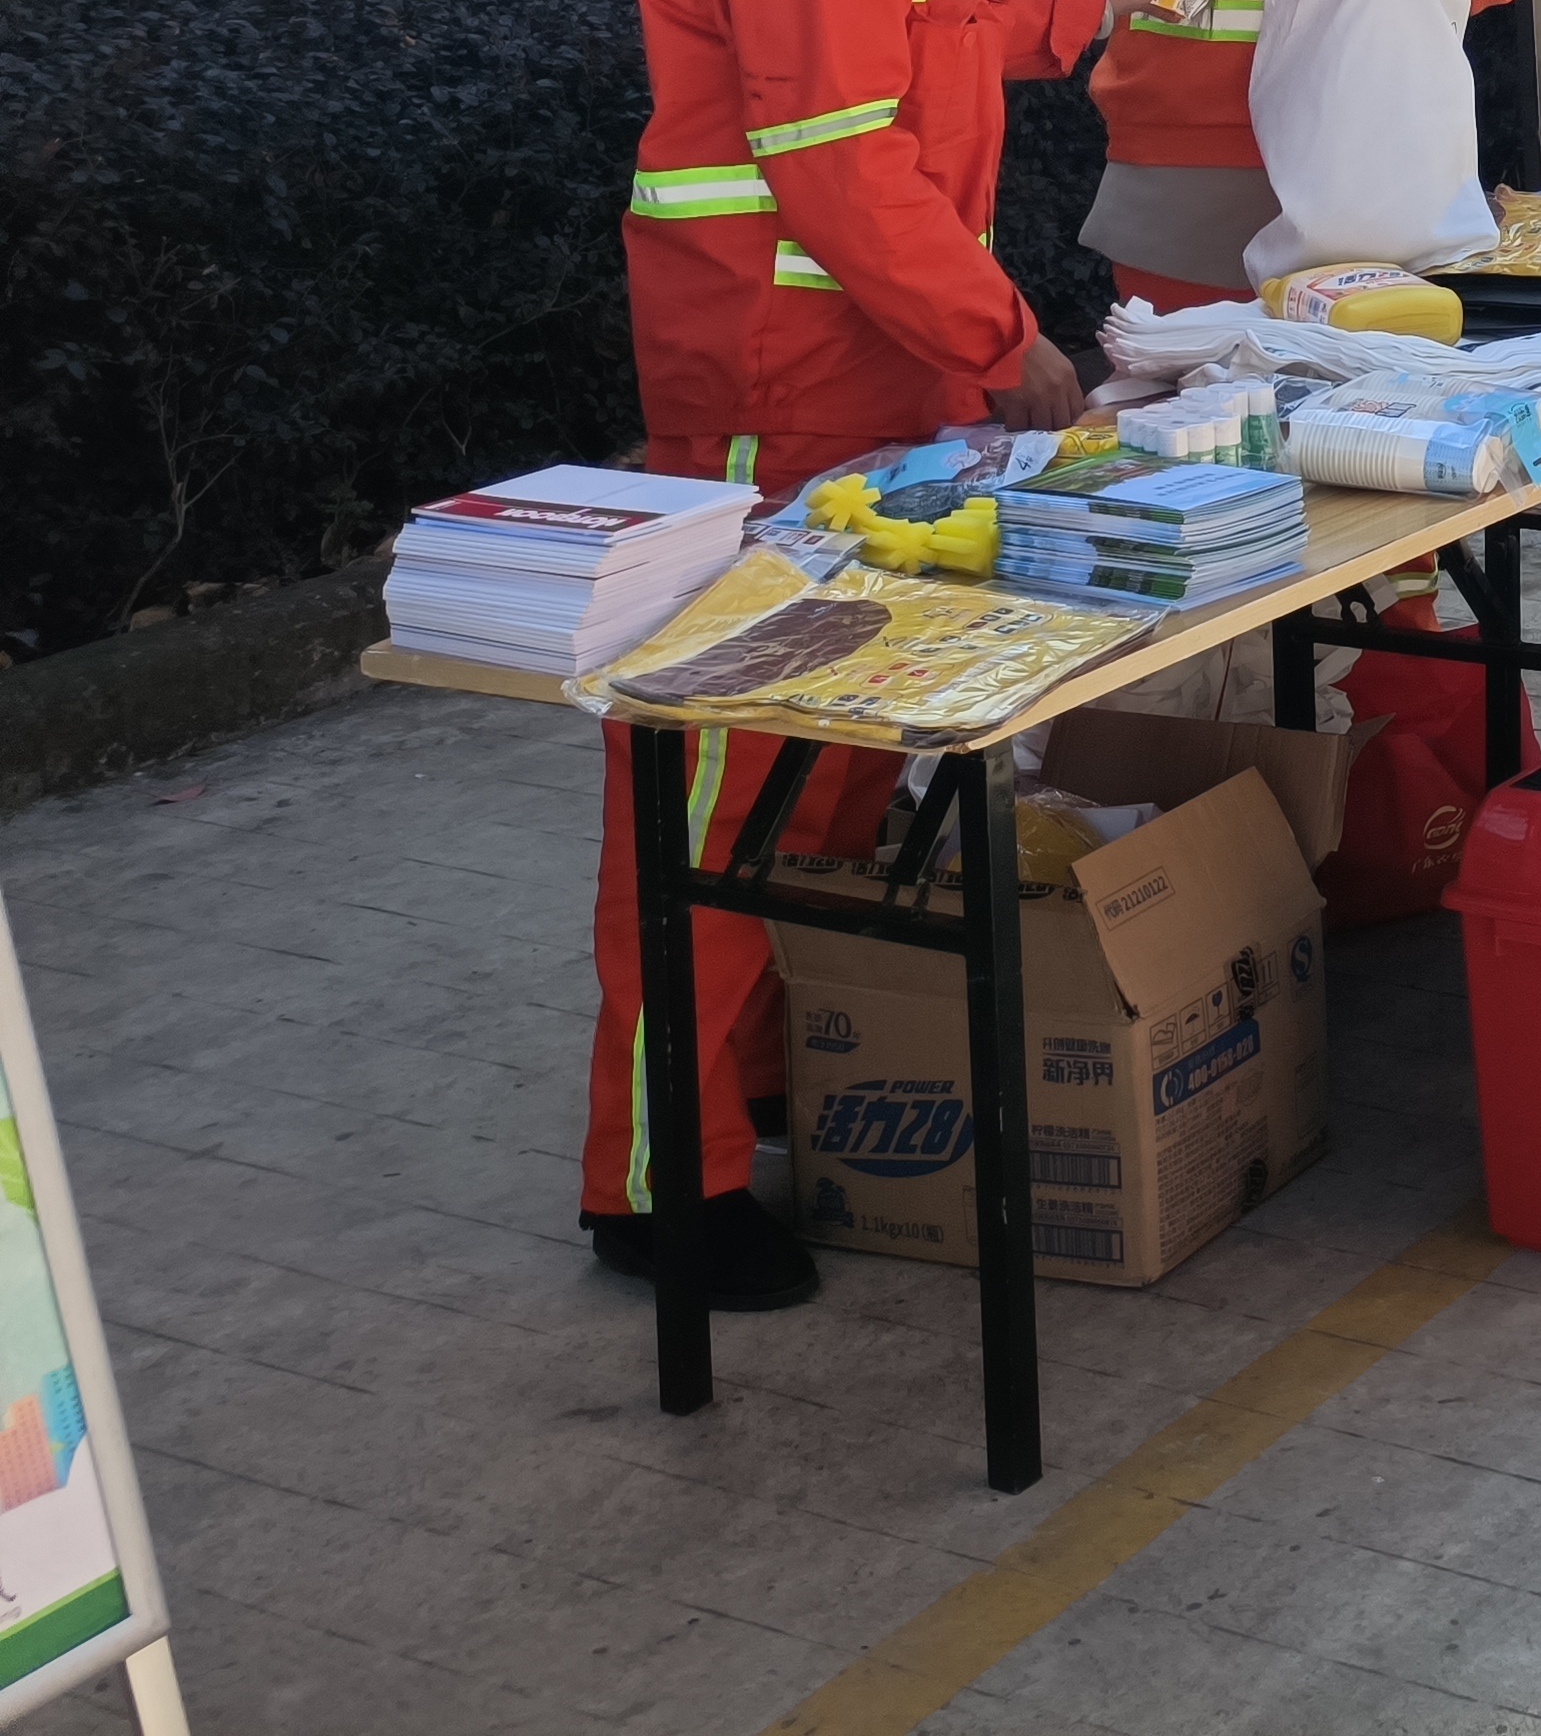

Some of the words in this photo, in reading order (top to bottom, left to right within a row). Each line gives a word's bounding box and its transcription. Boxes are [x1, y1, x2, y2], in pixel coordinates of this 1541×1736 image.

[1042, 1057, 1113, 1086] 新净界
[889, 1080, 956, 1094] POWER
[810, 1095, 964, 1155] 活力28
